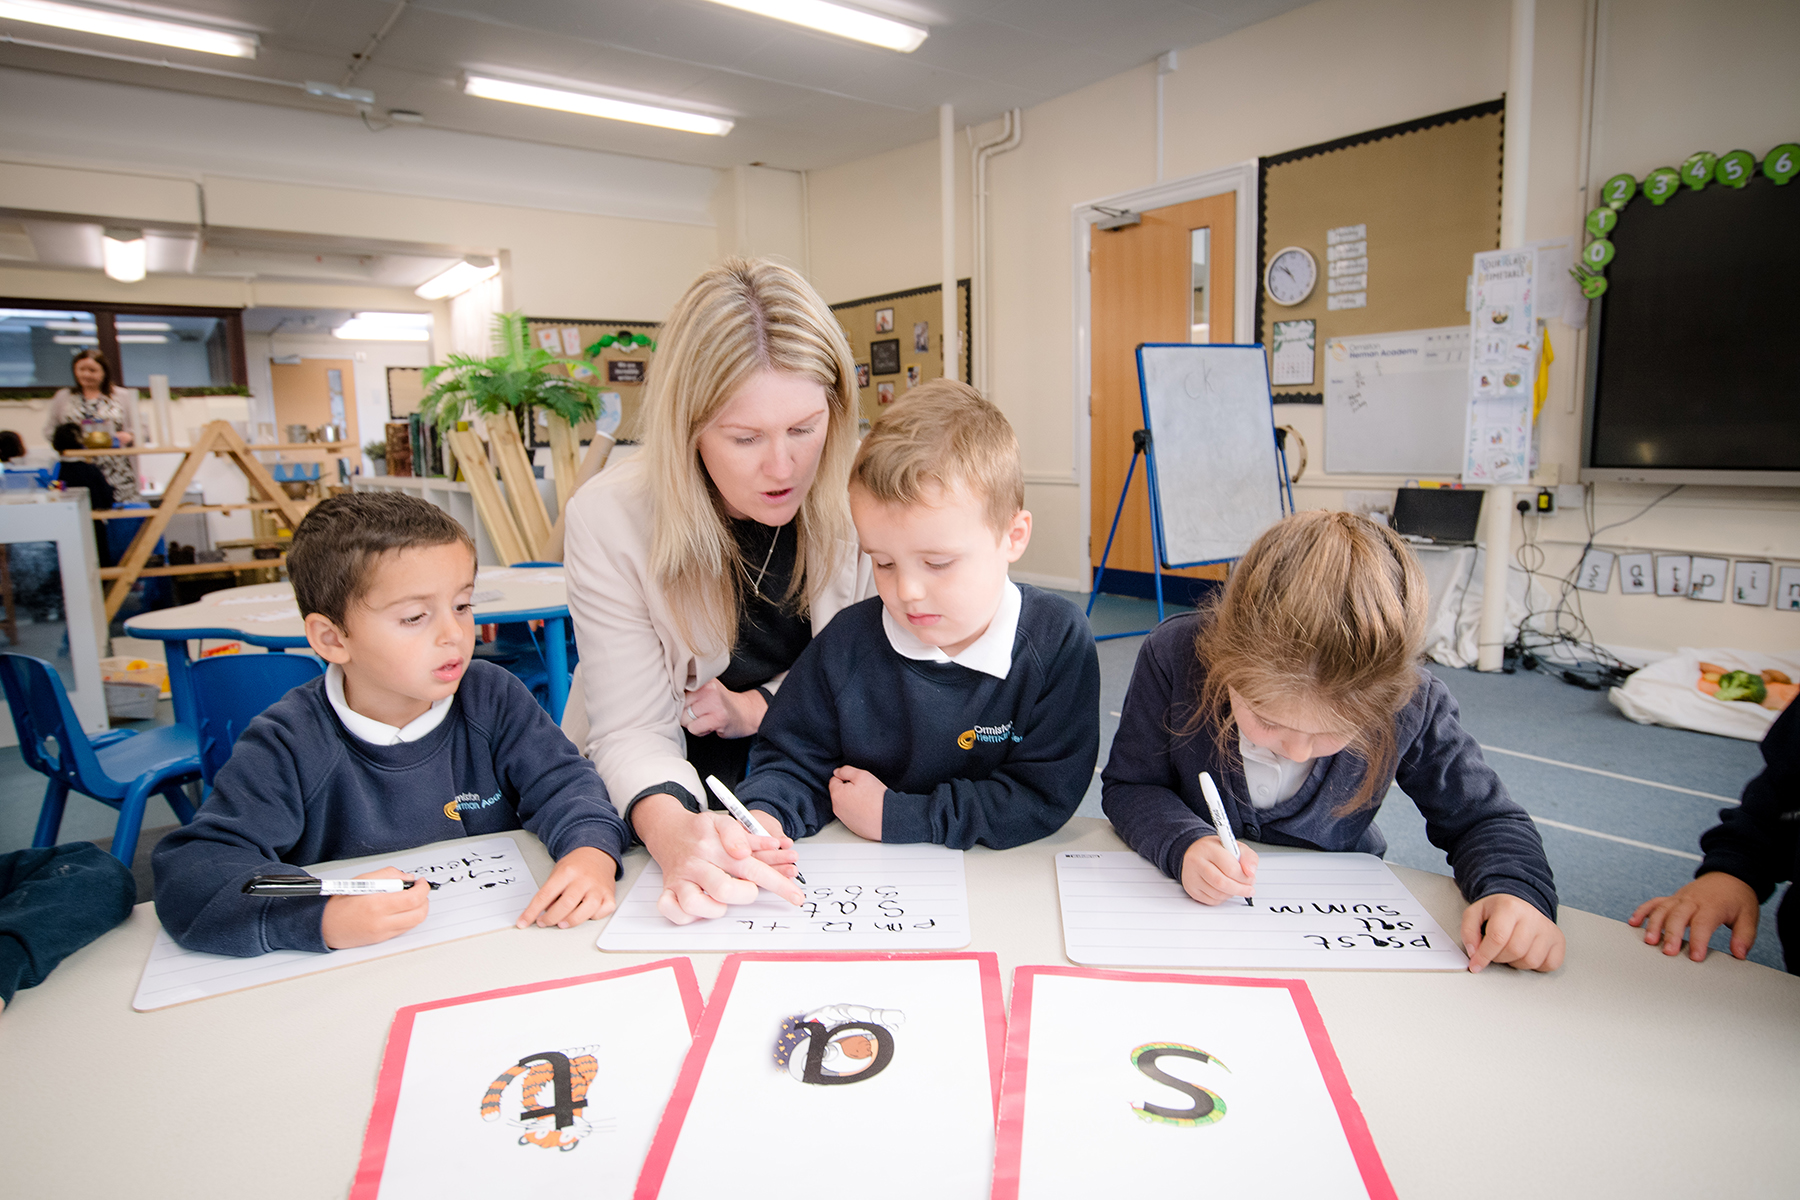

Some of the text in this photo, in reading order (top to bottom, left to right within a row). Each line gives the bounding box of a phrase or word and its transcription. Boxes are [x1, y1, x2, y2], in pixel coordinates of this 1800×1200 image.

[1690, 160, 1706, 179] 4
[1725, 158, 1744, 179] 5
[1775, 152, 1793, 173] 6
[1612, 180, 1628, 199] 2
[1652, 175, 1669, 195] 3
[1597, 211, 1606, 229] 1
[1590, 244, 1606, 262] 0
[1349, 342, 1381, 351] Ormiston
[1349, 347, 1419, 359] Herman Academy
[793, 1020, 895, 1087] a
[519, 1050, 588, 1131] t
